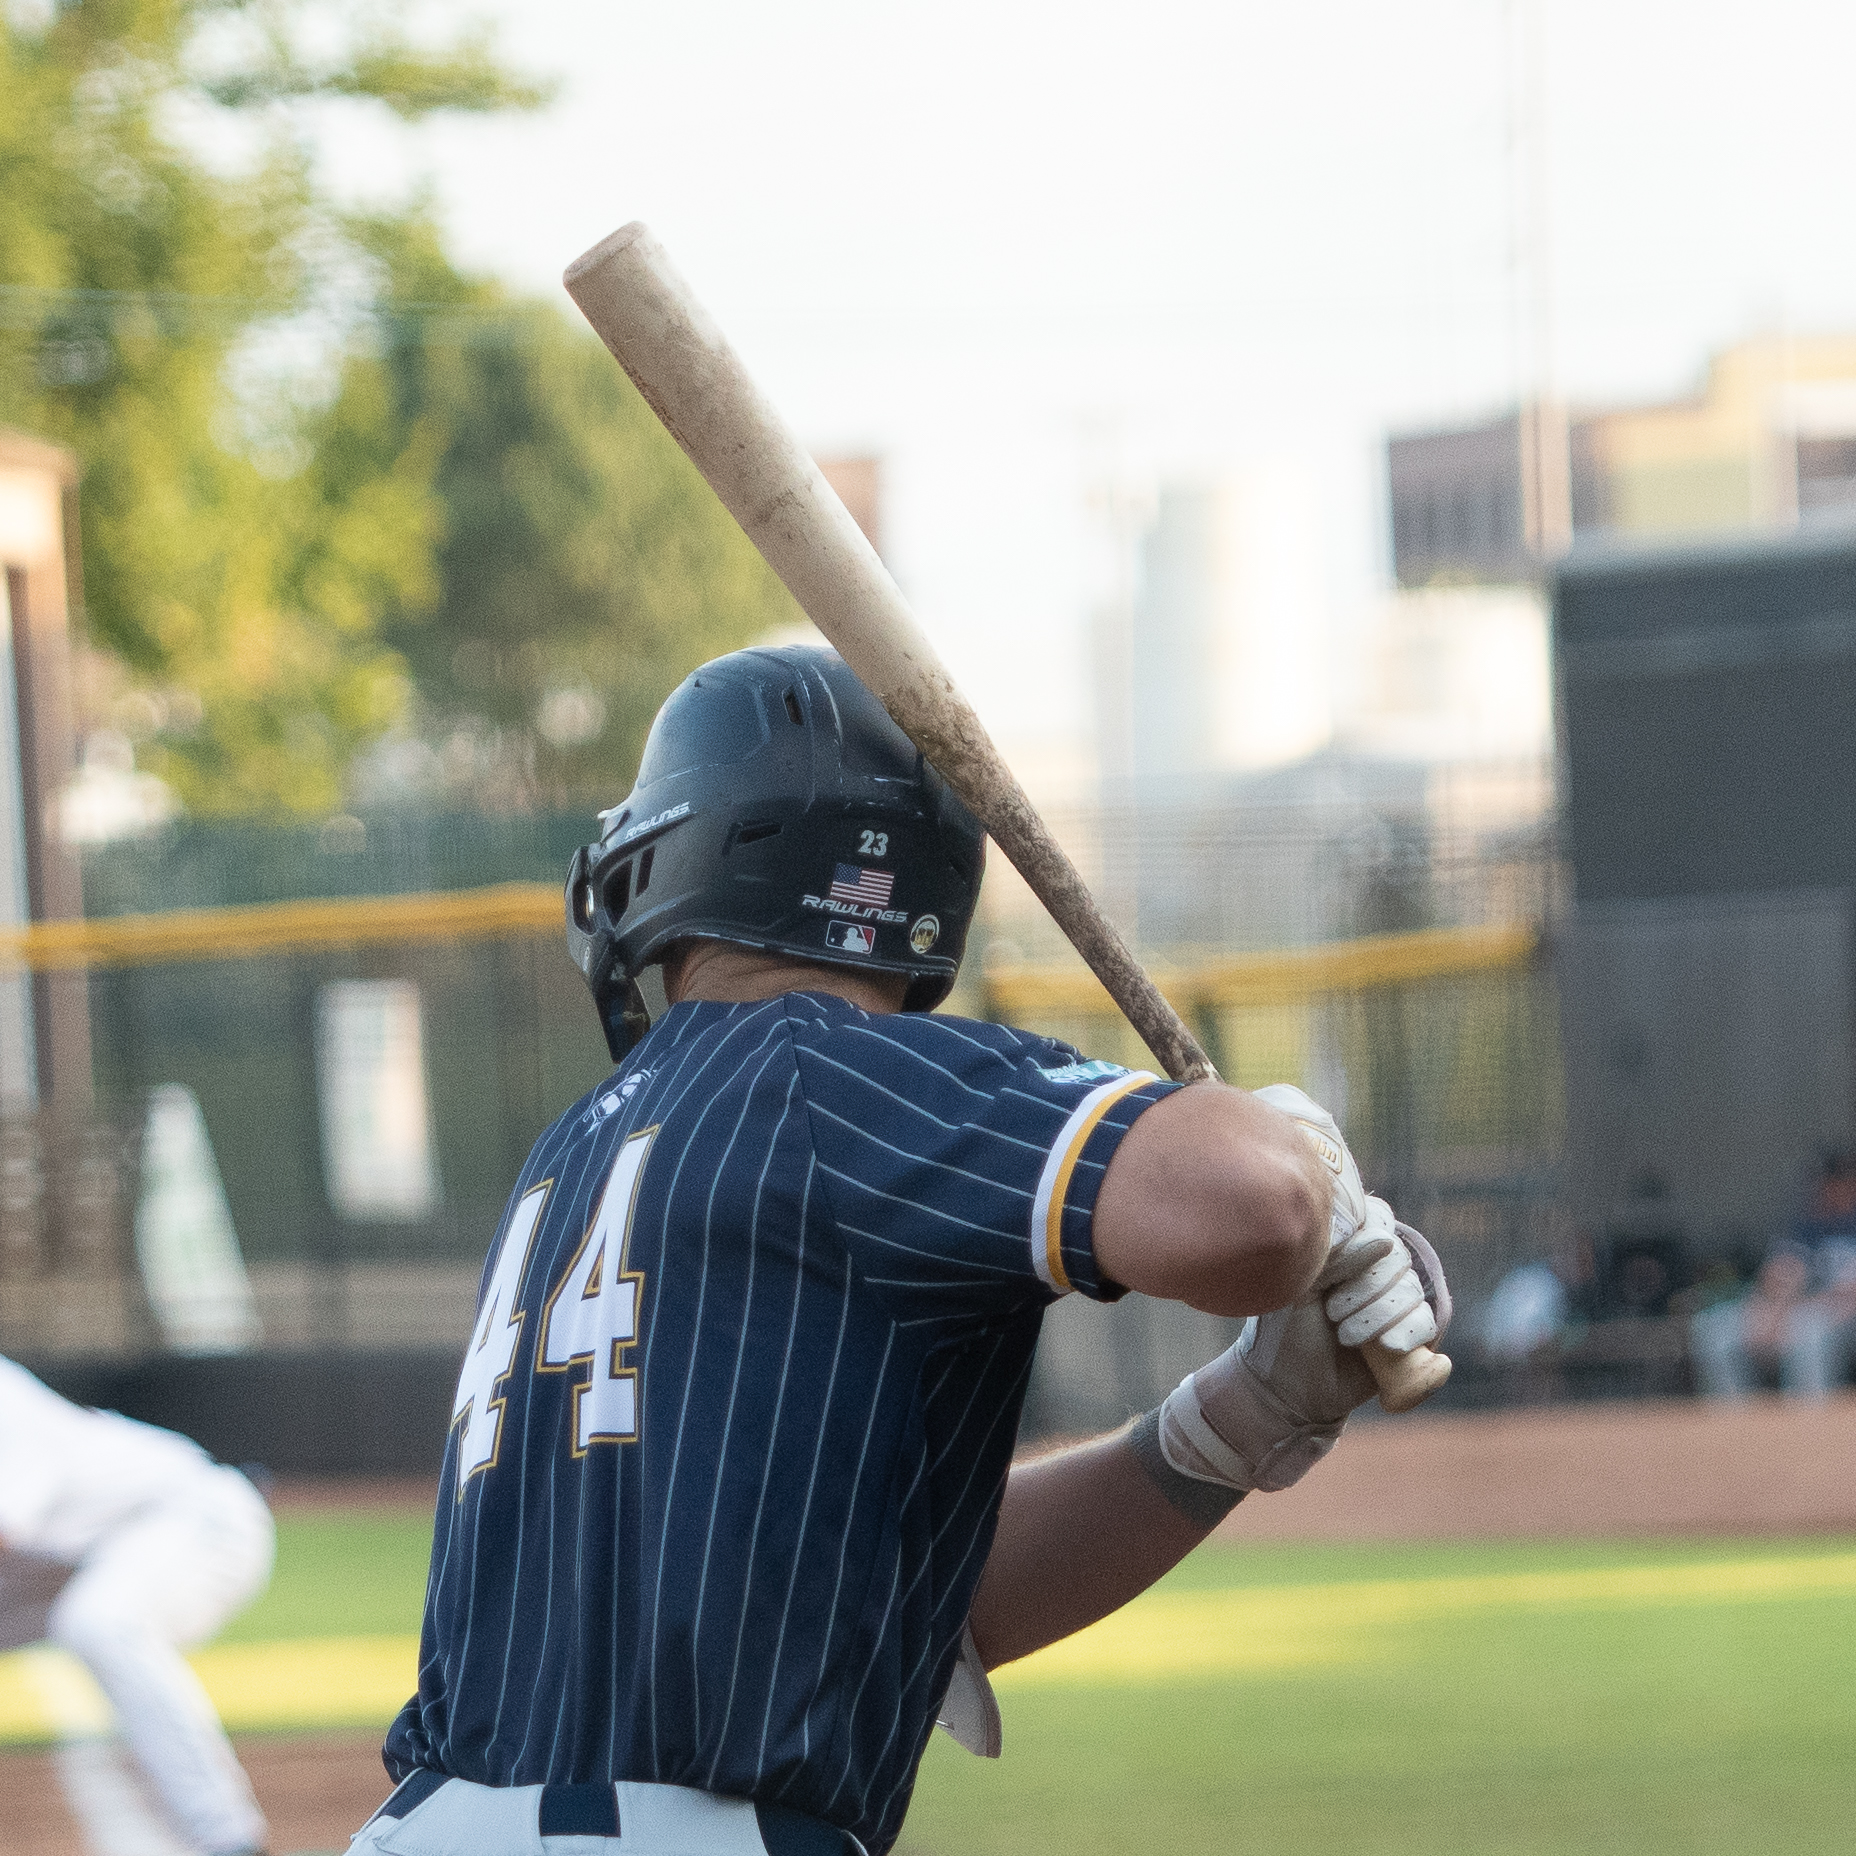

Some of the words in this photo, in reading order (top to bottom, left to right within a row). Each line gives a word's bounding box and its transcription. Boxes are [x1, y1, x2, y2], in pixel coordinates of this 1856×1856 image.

[625, 801, 691, 840] RAWLINGS
[857, 829, 890, 857] 23
[801, 894, 909, 924] RAWLINGS
[450, 1124, 660, 1504] 44
